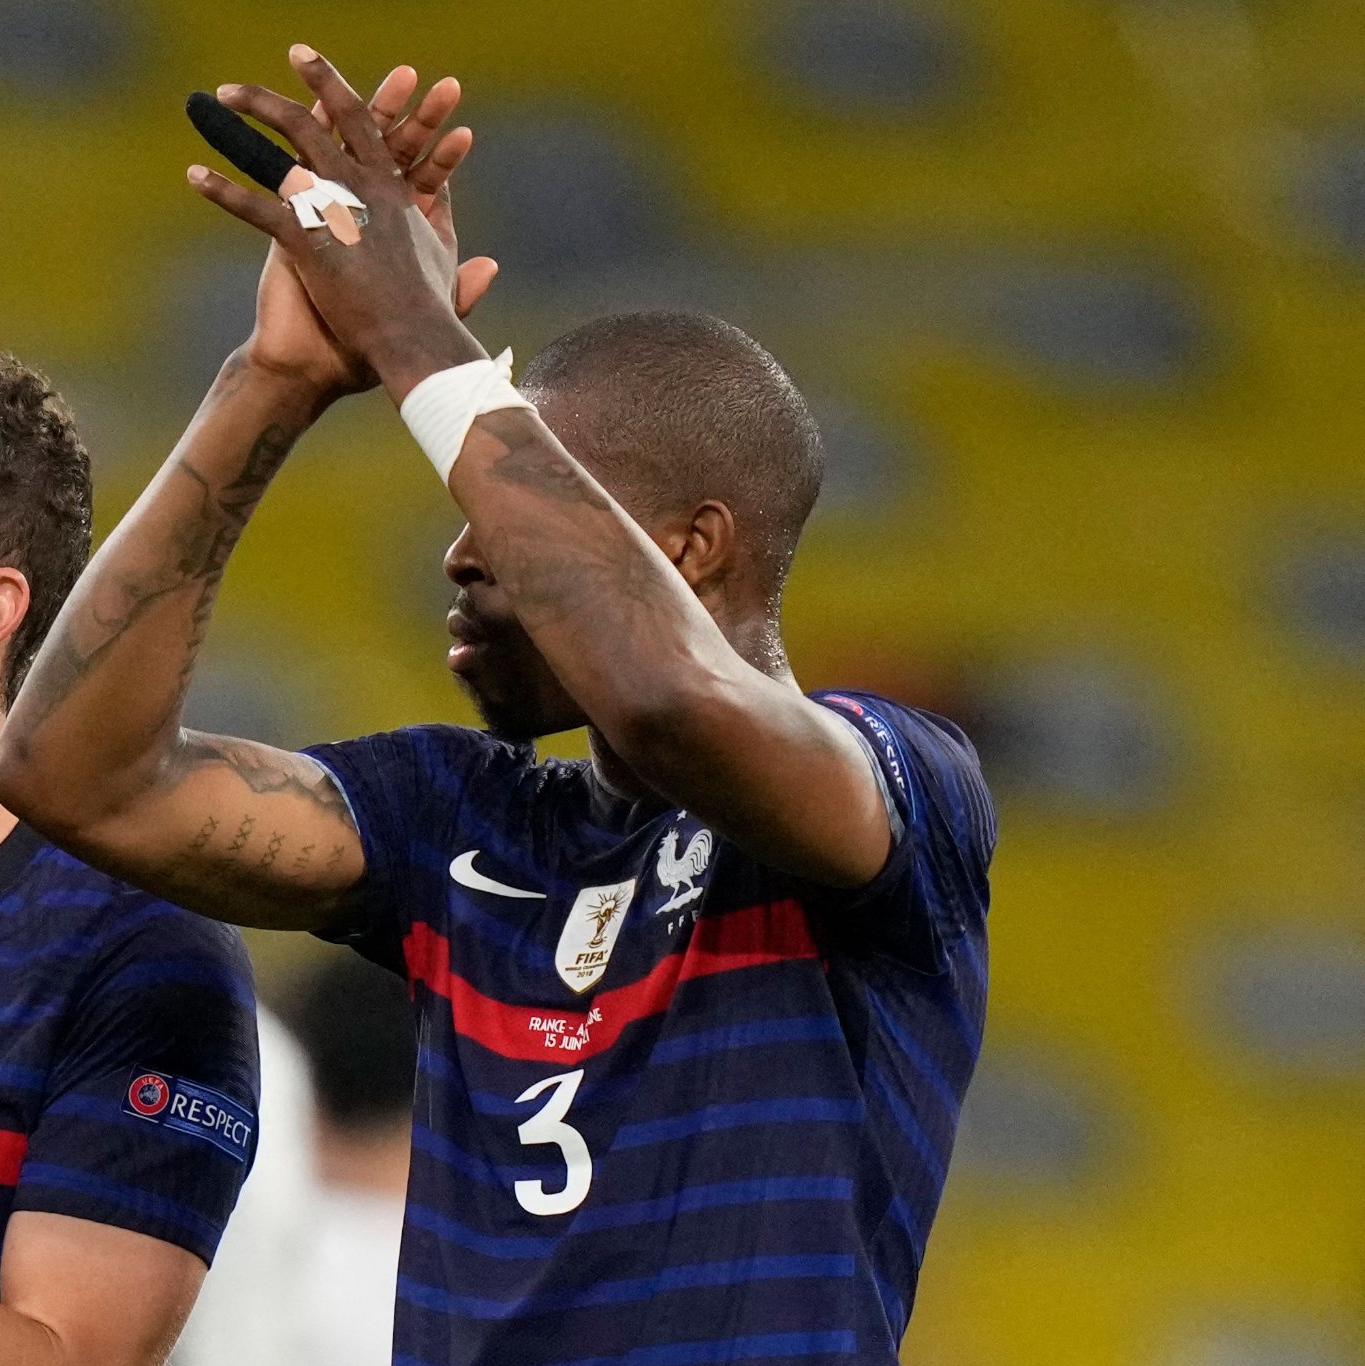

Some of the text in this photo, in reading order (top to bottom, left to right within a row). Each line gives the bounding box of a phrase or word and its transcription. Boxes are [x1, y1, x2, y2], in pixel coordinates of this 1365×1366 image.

[575, 951, 605, 965] FIFA
[528, 1016, 567, 1034] FRANCE
[544, 1033, 557, 1048] 15
[558, 1035, 583, 1051] JUIN
[170, 1093, 252, 1148] RESPECT
[514, 1068, 593, 1216] 3
